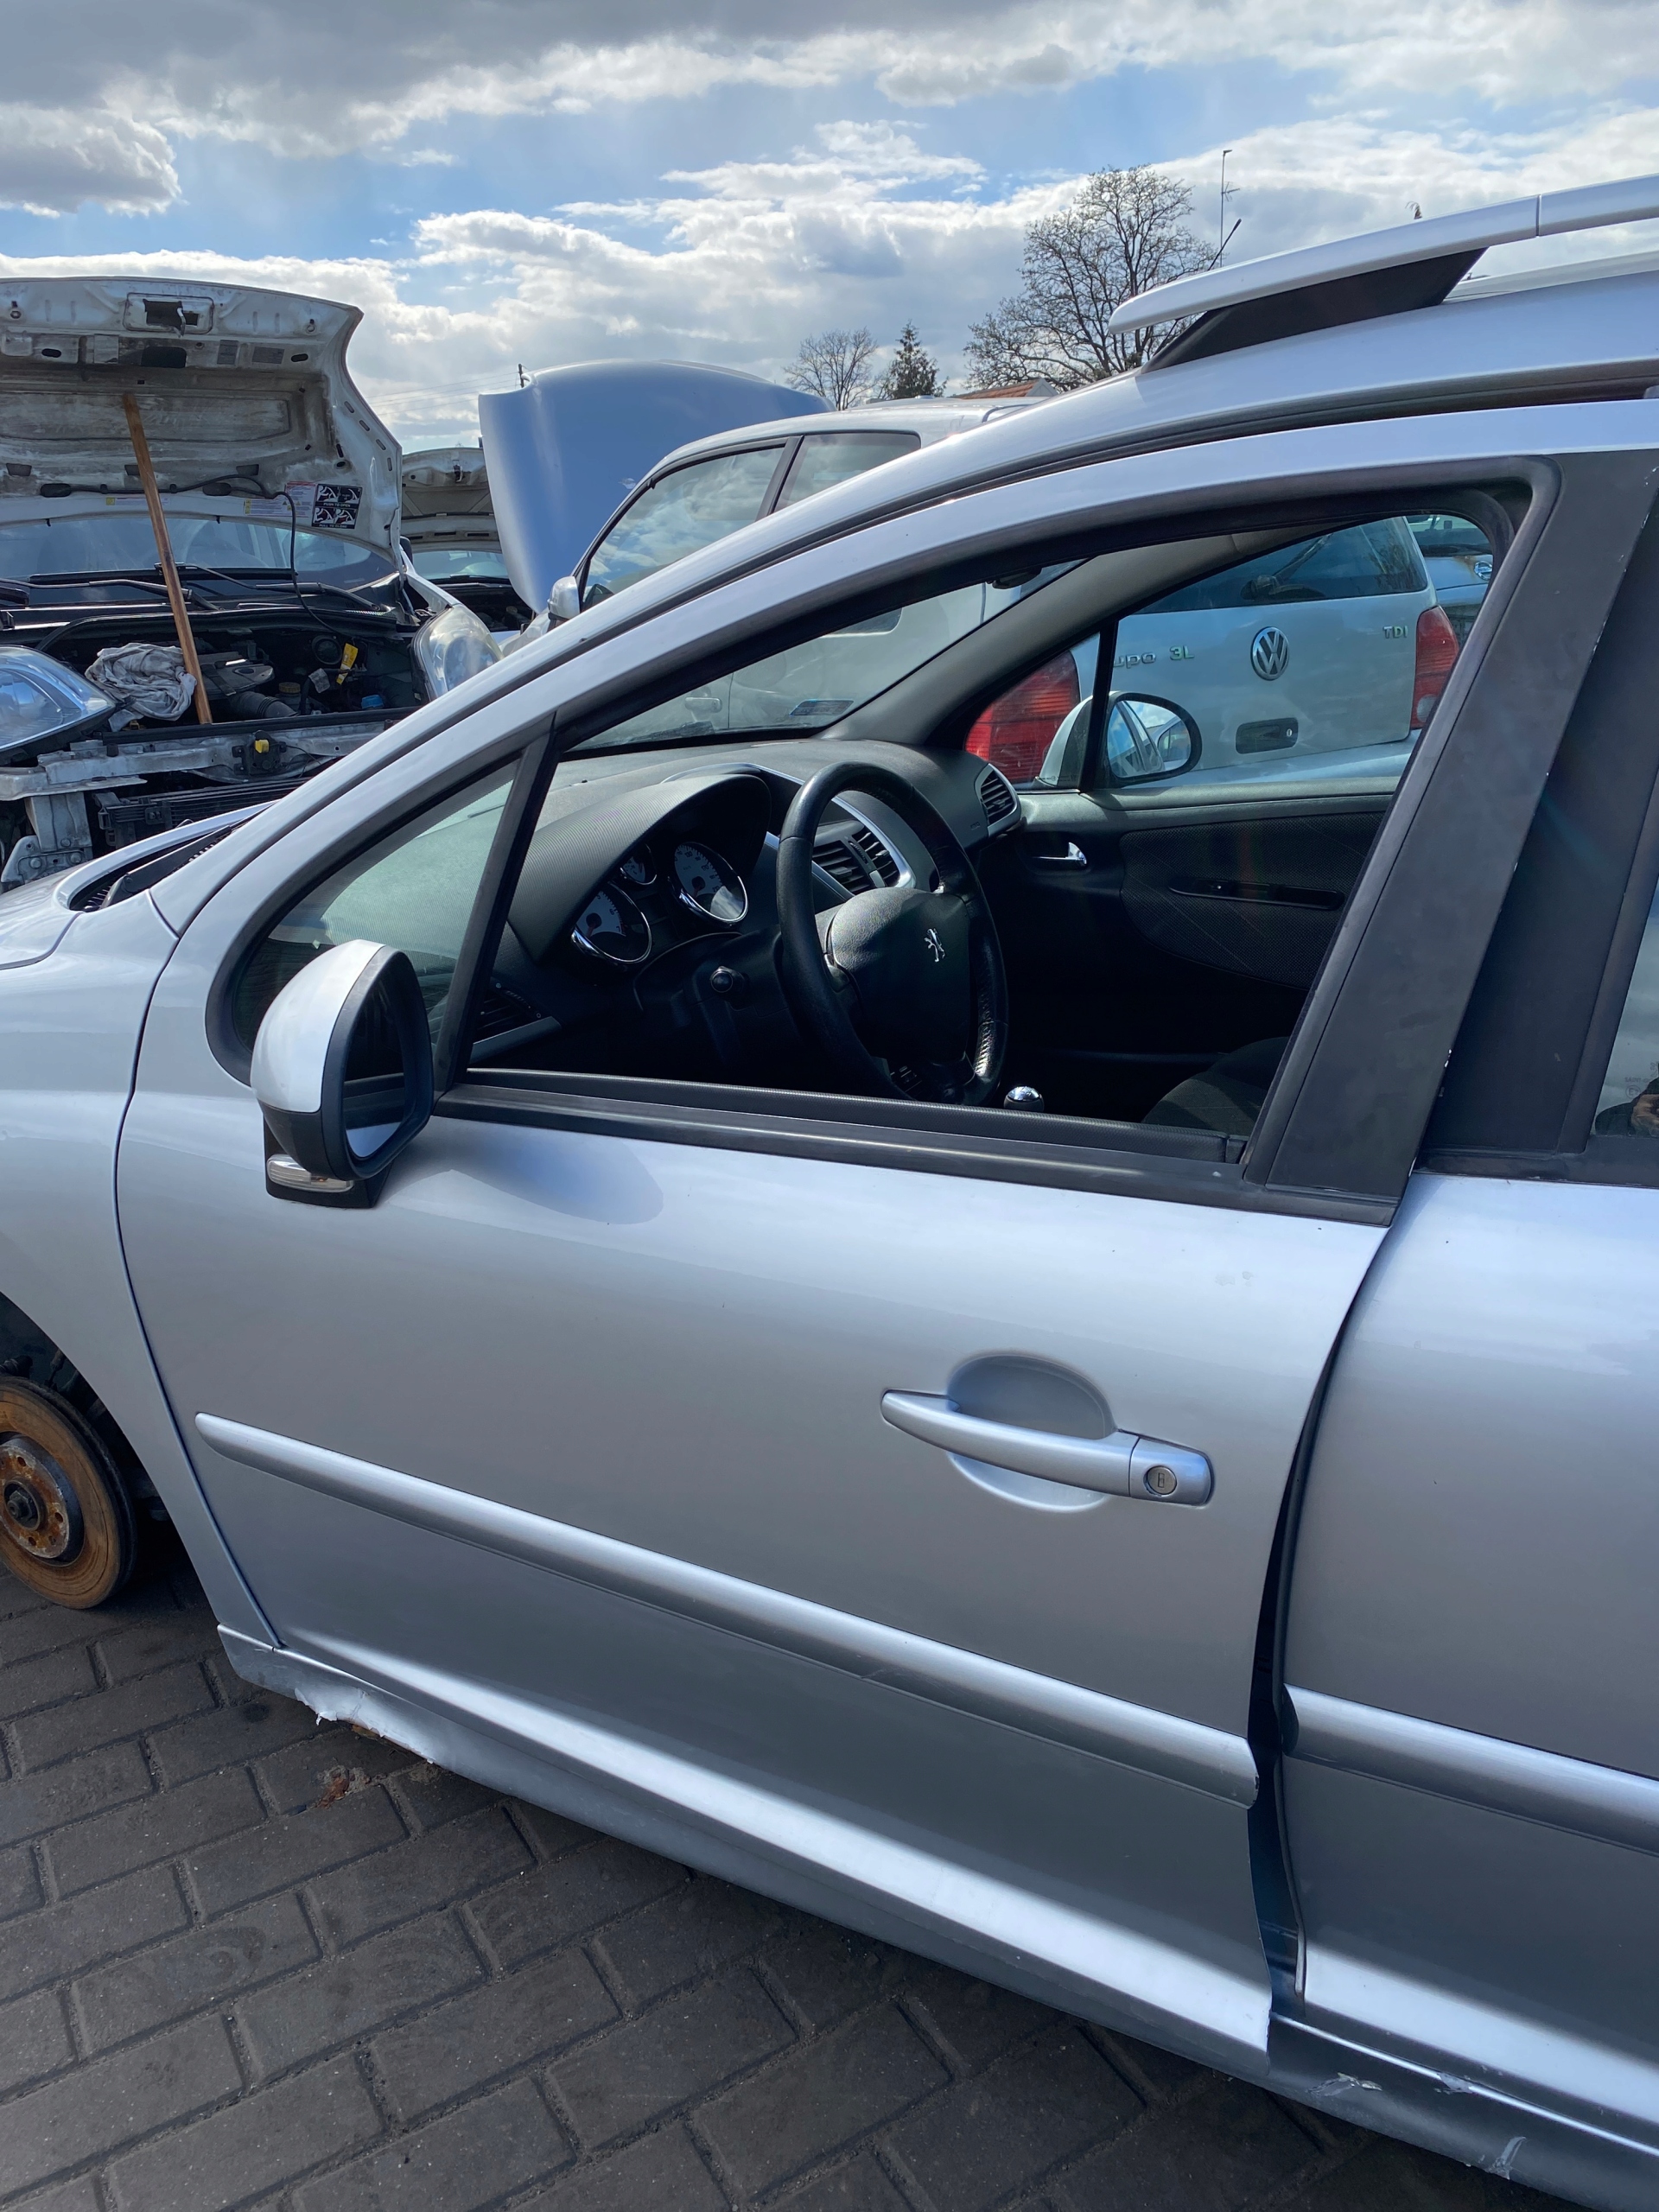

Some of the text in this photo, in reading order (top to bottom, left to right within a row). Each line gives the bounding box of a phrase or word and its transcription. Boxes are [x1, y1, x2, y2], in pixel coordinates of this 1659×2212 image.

[1382, 625, 1408, 639] TDI
[1113, 645, 1195, 670] upo 3L
